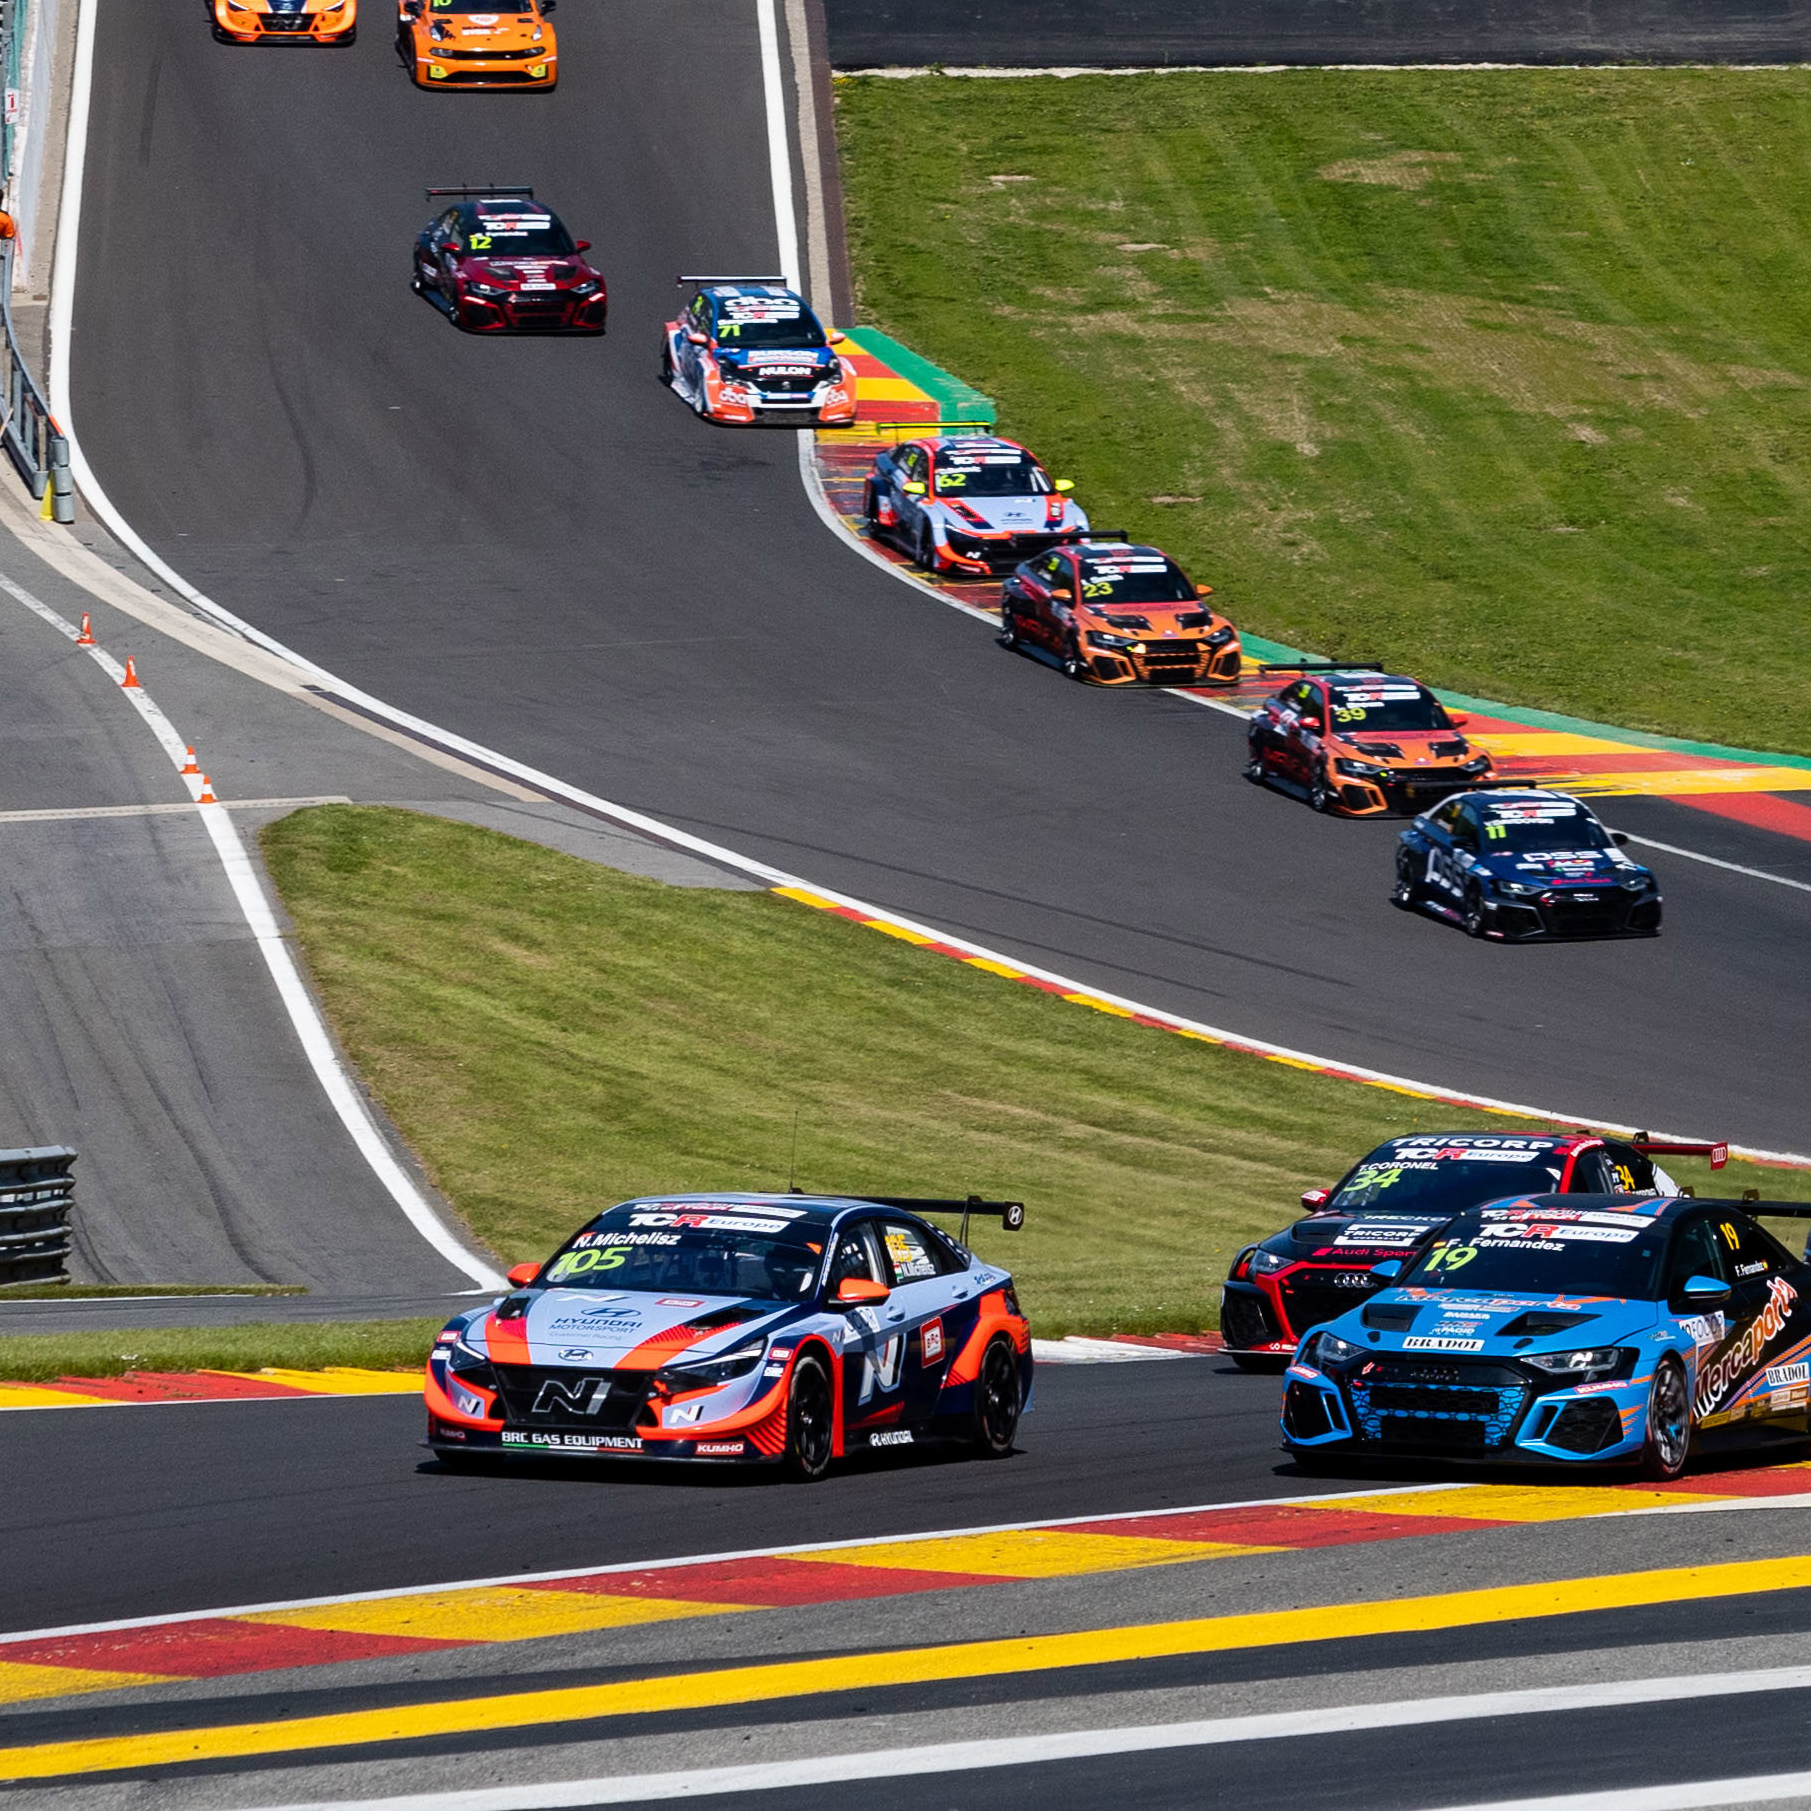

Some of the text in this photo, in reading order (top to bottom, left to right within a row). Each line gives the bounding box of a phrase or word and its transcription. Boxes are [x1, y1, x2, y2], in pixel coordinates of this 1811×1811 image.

[469, 234, 492, 249] 12
[718, 325, 740, 337] 71
[759, 367, 812, 375] NULON
[940, 473, 967, 488] 62
[1082, 582, 1113, 598] 23
[1334, 708, 1366, 722] 39
[1486, 826, 1506, 839] 11
[1392, 1137, 1554, 1150] TRICORP
[1394, 1147, 1534, 1160] TCR Europe
[1343, 1168, 1403, 1192] 34
[1615, 1165, 1636, 1190] 34
[628, 1213, 782, 1231] TCR Europe
[1479, 1223, 1633, 1239] TCR Europe
[1719, 1222, 1740, 1250] 19
[1446, 1238, 1566, 1252] F. Fernandez
[553, 1246, 633, 1276] 105
[1423, 1247, 1478, 1272] 19
[549, 1324, 636, 1334] MOTORSPORT
[555, 1318, 644, 1328] HYUNDAI
[1406, 1338, 1480, 1349] BRADOL
[1767, 1364, 1809, 1385] BRADOL
[502, 1431, 643, 1449] BRC GAS EQUIPMENT
[696, 1443, 744, 1453] KUMHO
